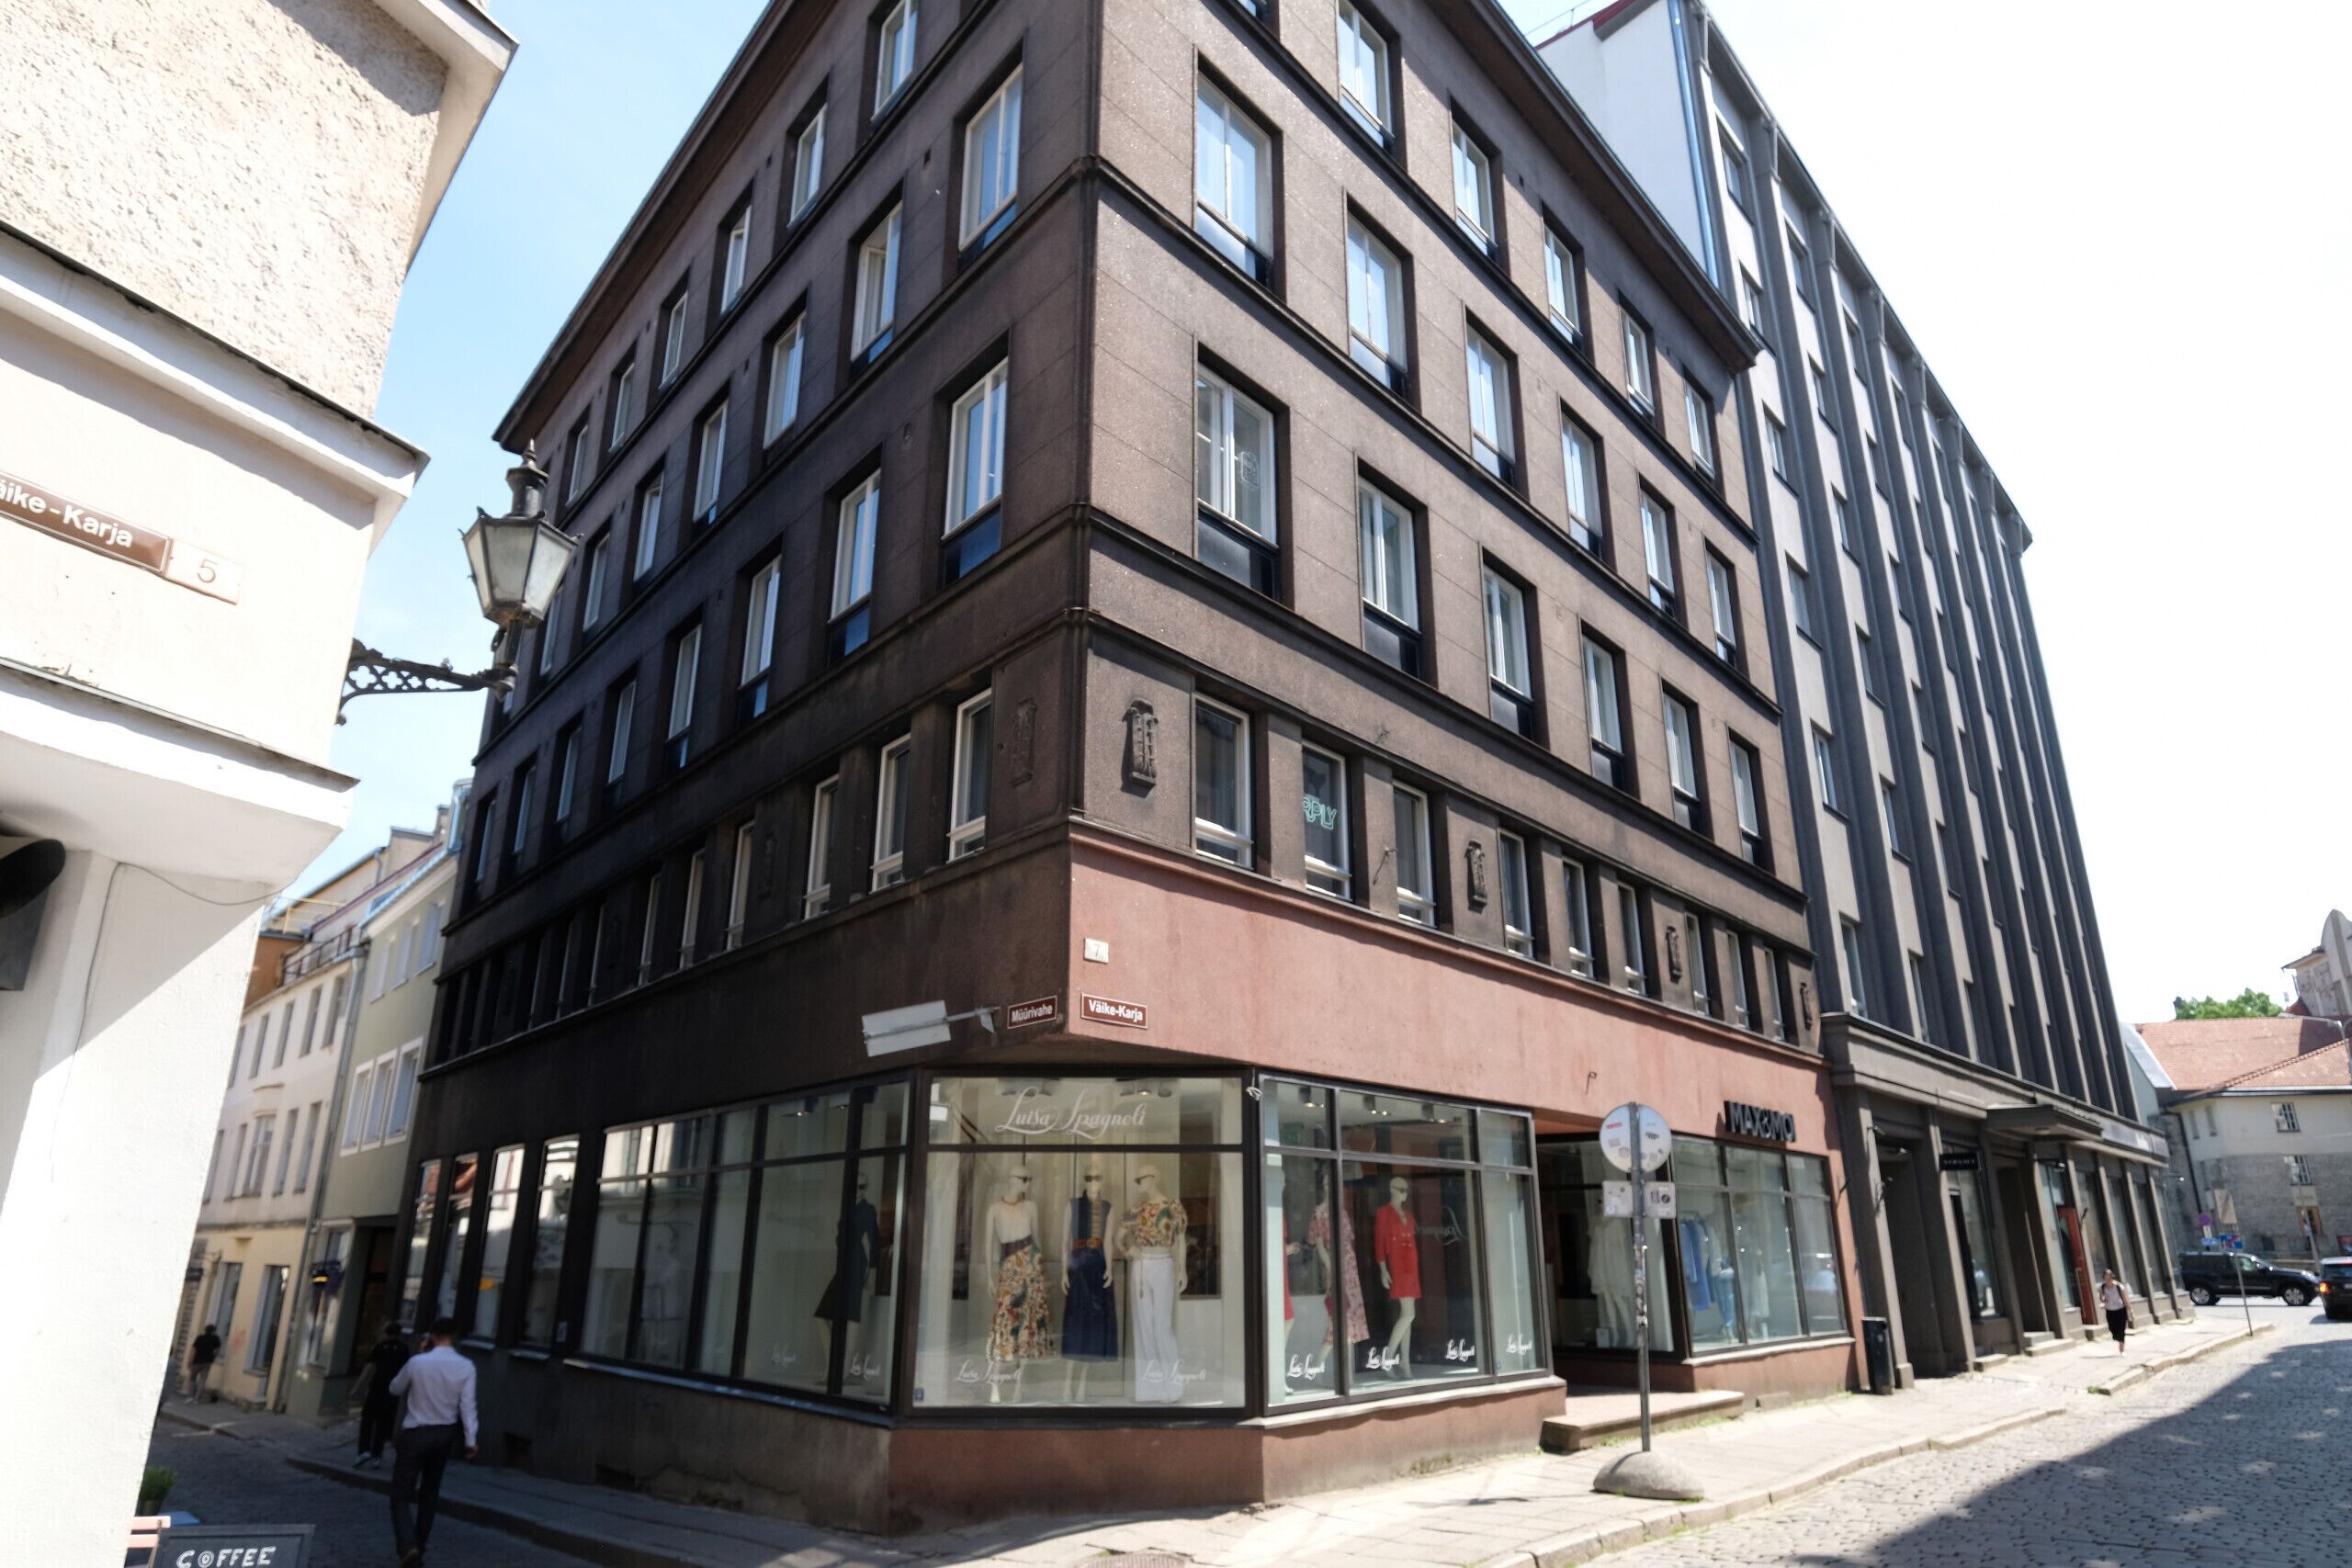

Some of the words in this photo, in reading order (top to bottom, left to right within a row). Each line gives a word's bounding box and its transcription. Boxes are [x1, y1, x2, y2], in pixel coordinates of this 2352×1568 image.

[197, 558, 219, 583] 5
[1012, 1004, 1053, 1022] Müürivahe
[1089, 999, 1144, 1022] Väike-Karja
[995, 1086, 1059, 1134] Luisa
[1057, 1088, 1148, 1140] Spagnoli
[176, 1546, 276, 1568] COFFEE
